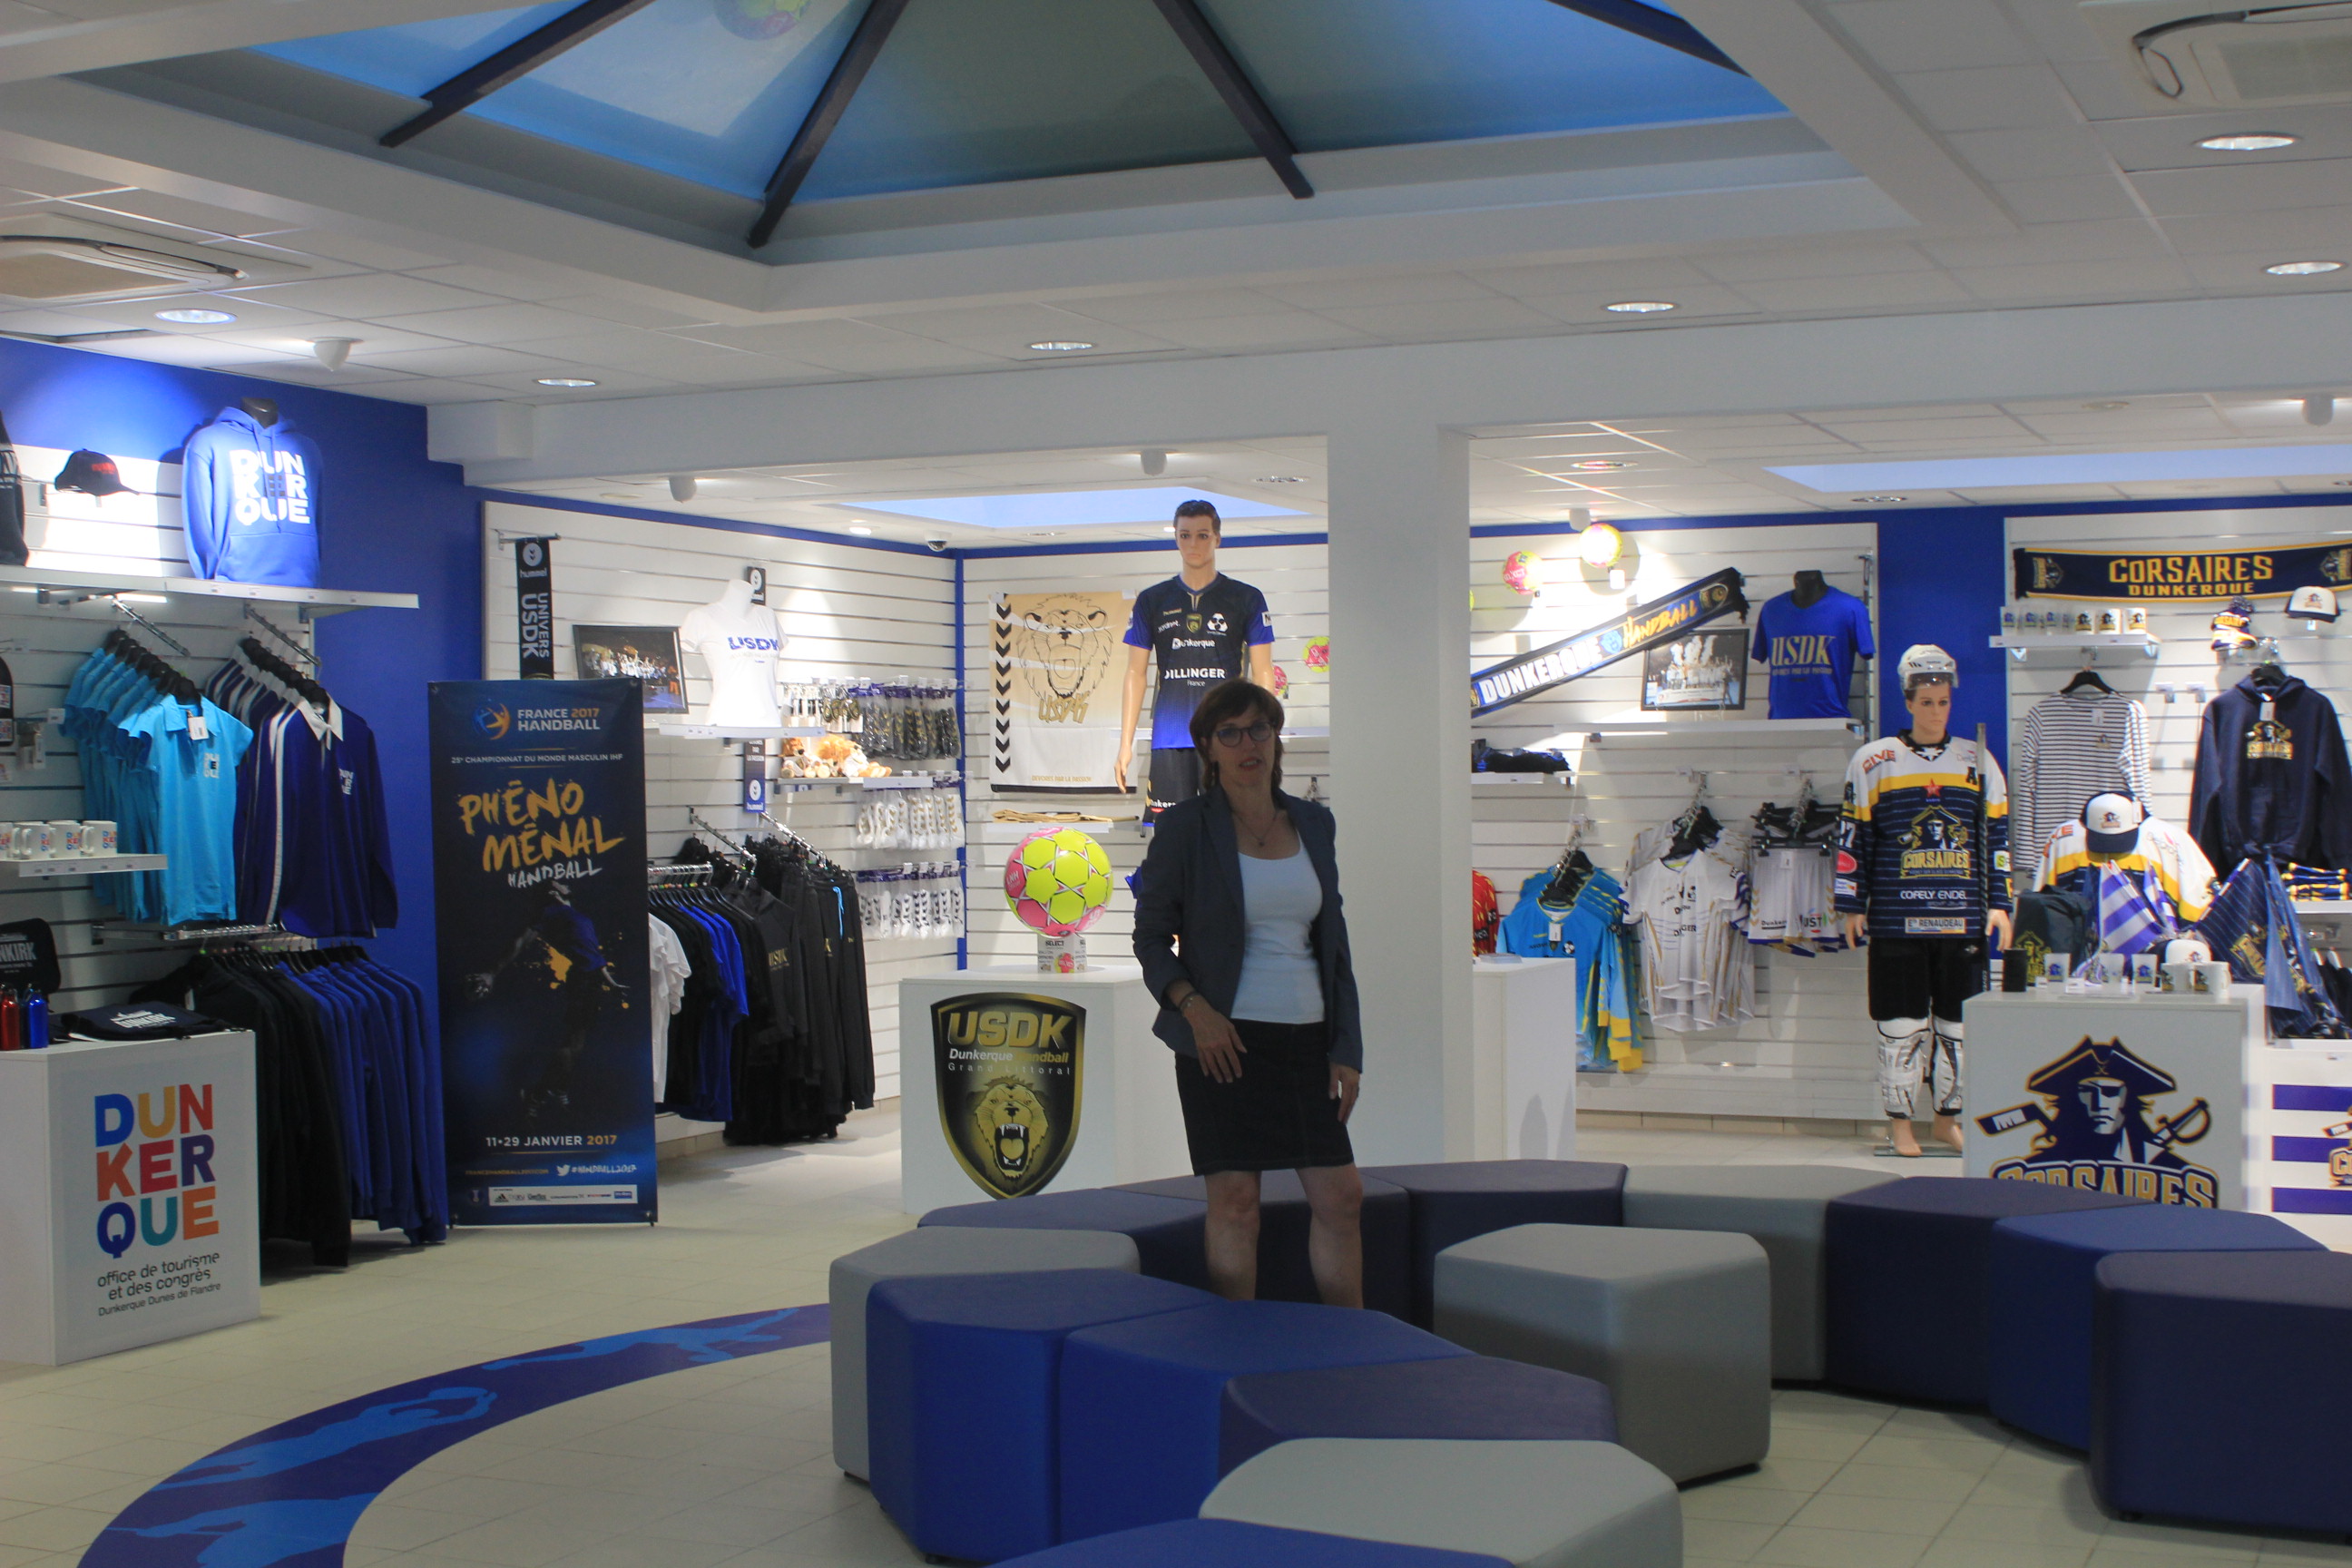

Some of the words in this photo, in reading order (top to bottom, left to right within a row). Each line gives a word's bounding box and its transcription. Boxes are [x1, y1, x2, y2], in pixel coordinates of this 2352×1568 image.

[229, 449, 306, 475] DUN
[235, 496, 310, 525] QUE
[2109, 555, 2273, 583] CORSAIRES
[2128, 582, 2255, 596] DUNKERQUE
[521, 593, 539, 659] USDK
[537, 593, 550, 658] UNIVERS
[1478, 636, 1602, 704] DUNKERQUE
[1622, 600, 1697, 648] HANDBALL
[1771, 635, 1836, 666] USDK
[517, 709, 568, 719] FRANCE
[571, 708, 600, 718] 2017
[517, 718, 601, 731] HANDBALL
[1966, 767, 1977, 785] A
[508, 858, 603, 888] HANDBALL
[1904, 851, 1969, 868] CORSAIRES
[1900, 890, 1936, 899] COFELY
[1919, 918, 1963, 927] RENAUDEAU
[948, 1011, 1073, 1048] USDK
[948, 1063, 994, 1073] Grand
[949, 1048, 1014, 1062] Dunkerque
[93, 1083, 213, 1147] DUN
[524, 1136, 583, 1146] JANVIER
[587, 1135, 616, 1145] 2017
[96, 1133, 216, 1201] KER
[1997, 1167, 2212, 1208] SAIRES
[96, 1186, 220, 1259] QUE
[97, 1270, 136, 1288] office
[141, 1264, 158, 1279] de
[162, 1252, 220, 1274] tourisme
[109, 1286, 122, 1300] et
[127, 1281, 152, 1297] des
[156, 1269, 211, 1290] congrès
[98, 1299, 146, 1317] Dunkerque
[148, 1293, 175, 1306] Dunes
[177, 1290, 188, 1299] de
[191, 1282, 221, 1296] Flandre
